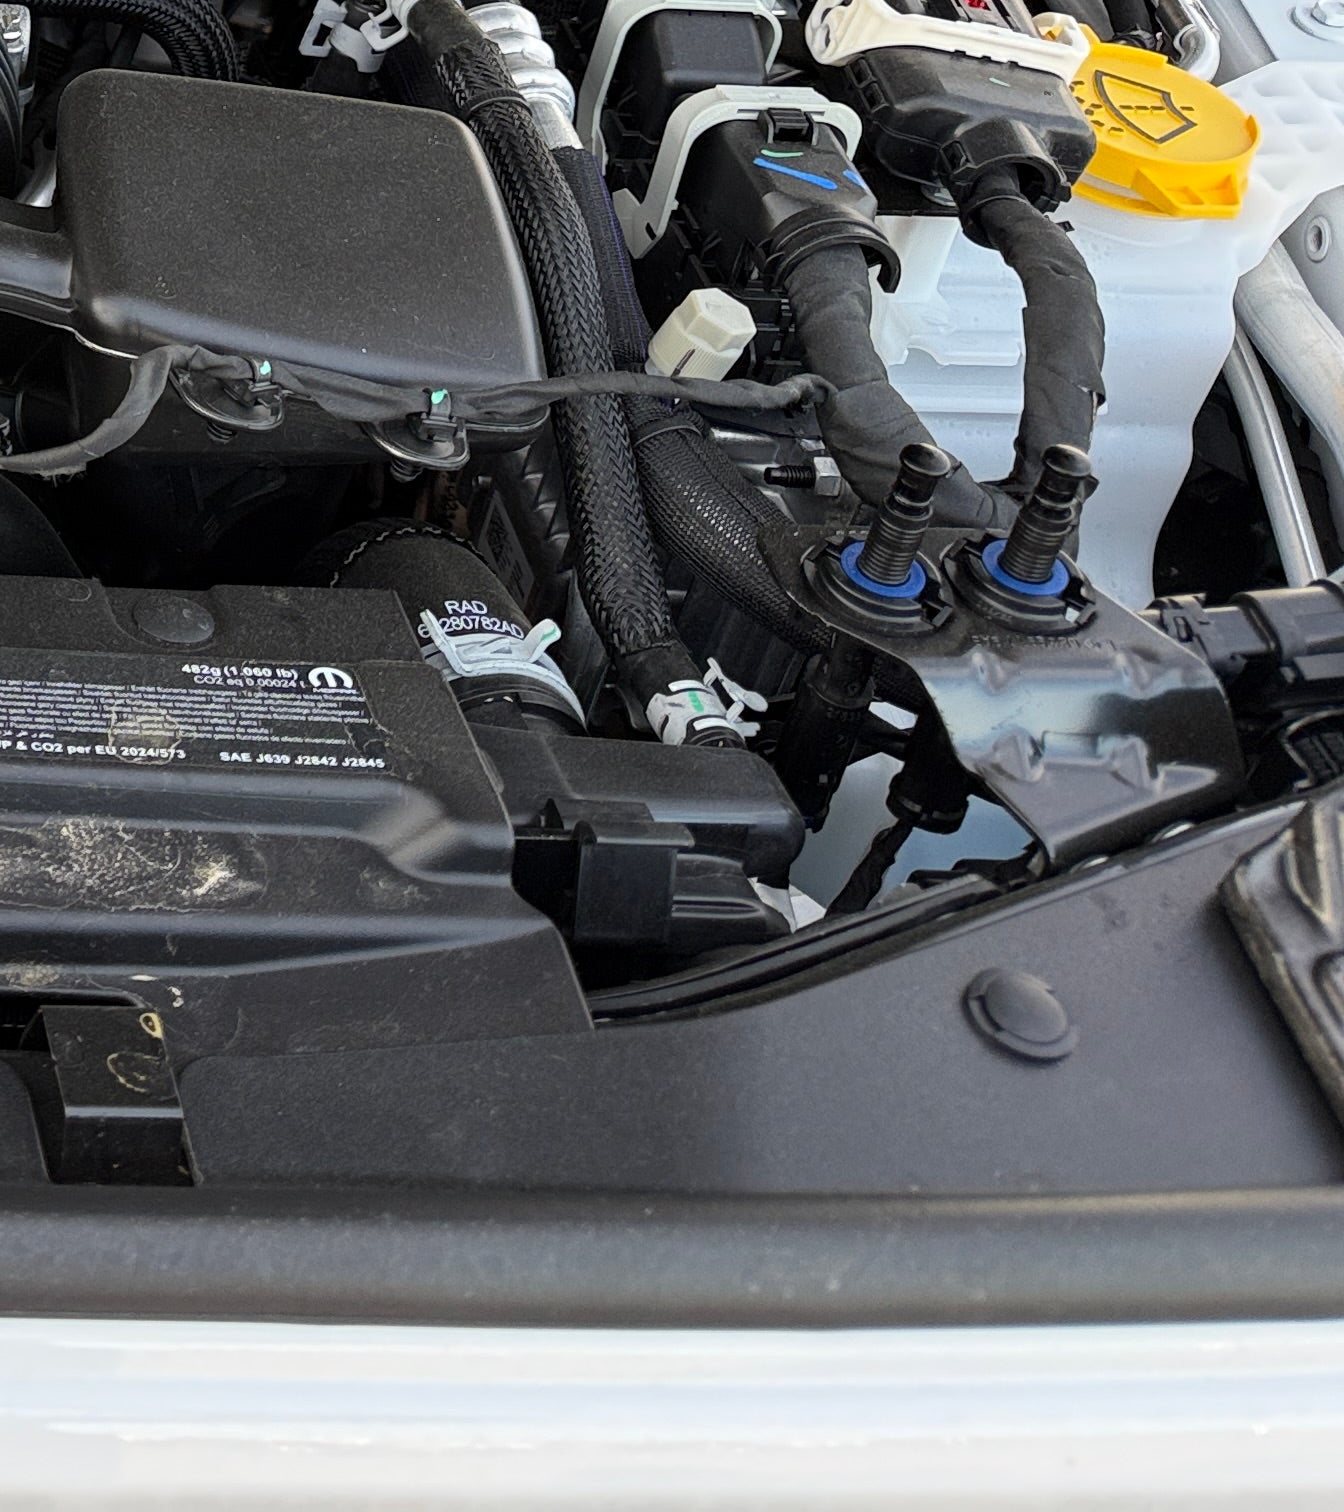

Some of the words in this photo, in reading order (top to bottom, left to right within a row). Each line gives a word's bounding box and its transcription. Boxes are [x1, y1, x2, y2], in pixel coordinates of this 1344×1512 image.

[444, 600, 488, 615] RAD
[417, 615, 524, 639] 6280782AD
[193, 675, 224, 685] CO2
[275, 668, 299, 680] lb)
[15, 740, 28, 751] &
[30, 741, 63, 753] CO2
[66, 745, 92, 756] per
[94, 745, 117, 756] EU
[219, 751, 253, 763] SAE
